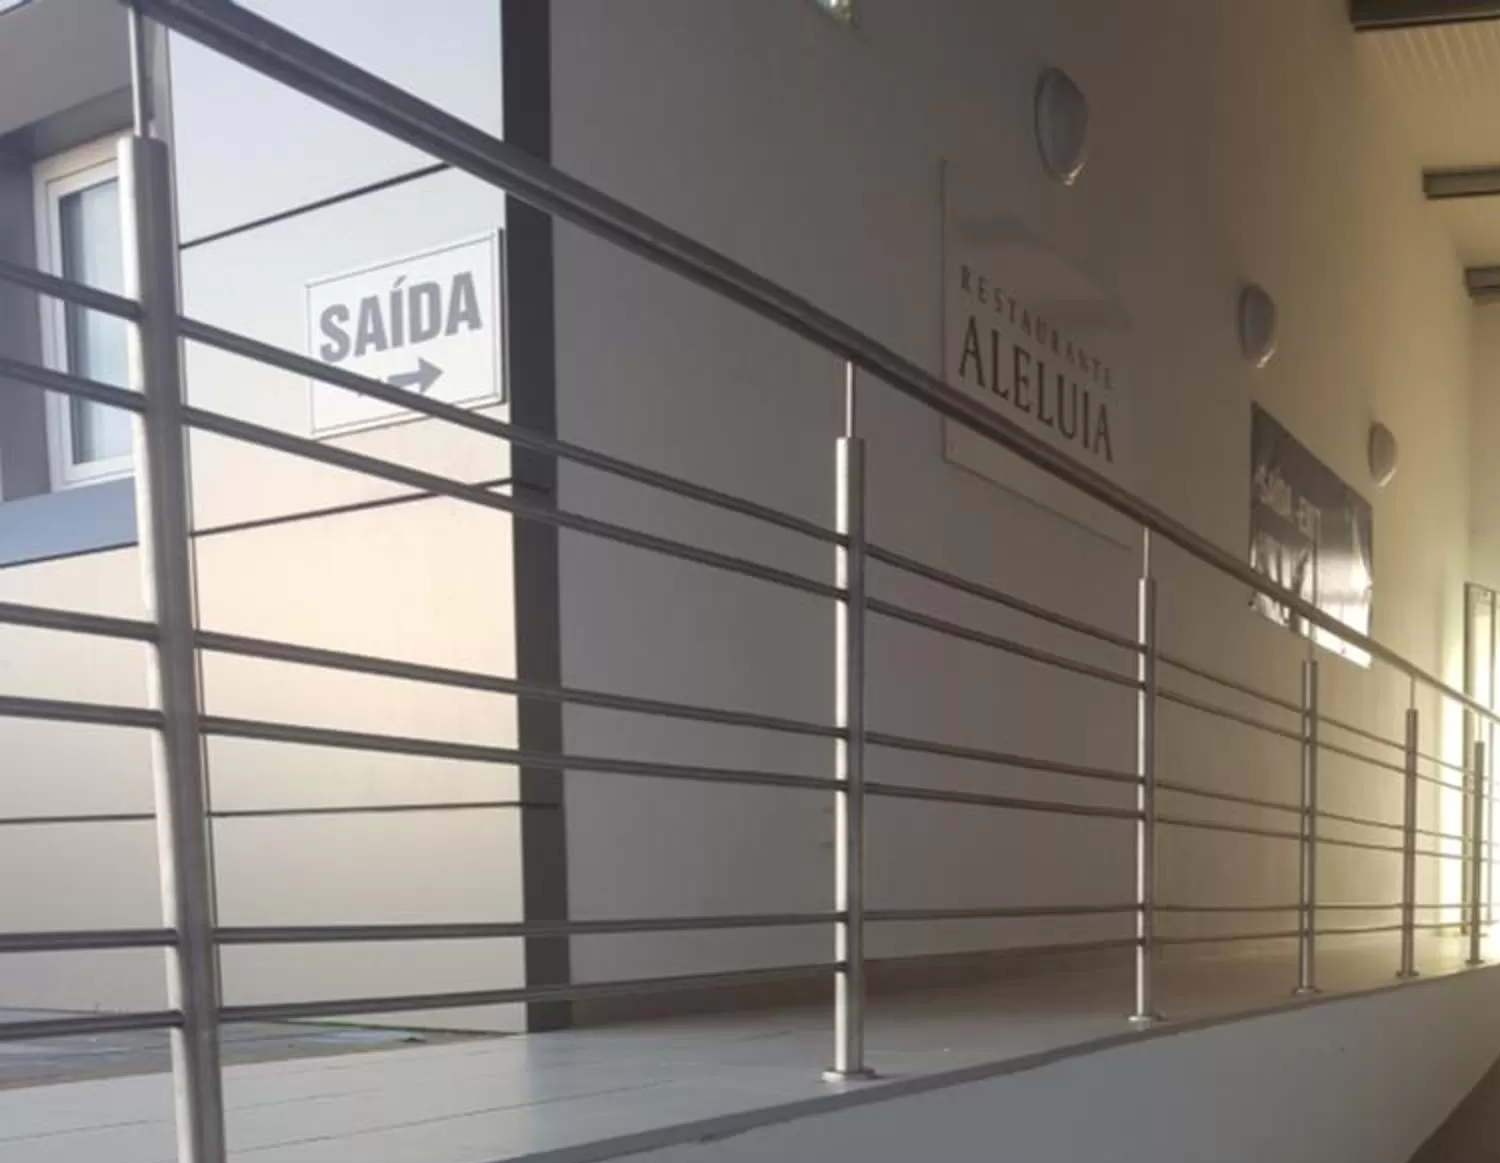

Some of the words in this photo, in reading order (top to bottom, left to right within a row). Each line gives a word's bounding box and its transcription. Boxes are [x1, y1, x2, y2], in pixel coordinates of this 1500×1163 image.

[319, 270, 483, 363] SAÍDA
[960, 264, 1113, 391] RESTAURANTE
[958, 315, 1113, 462] ALELUIA
